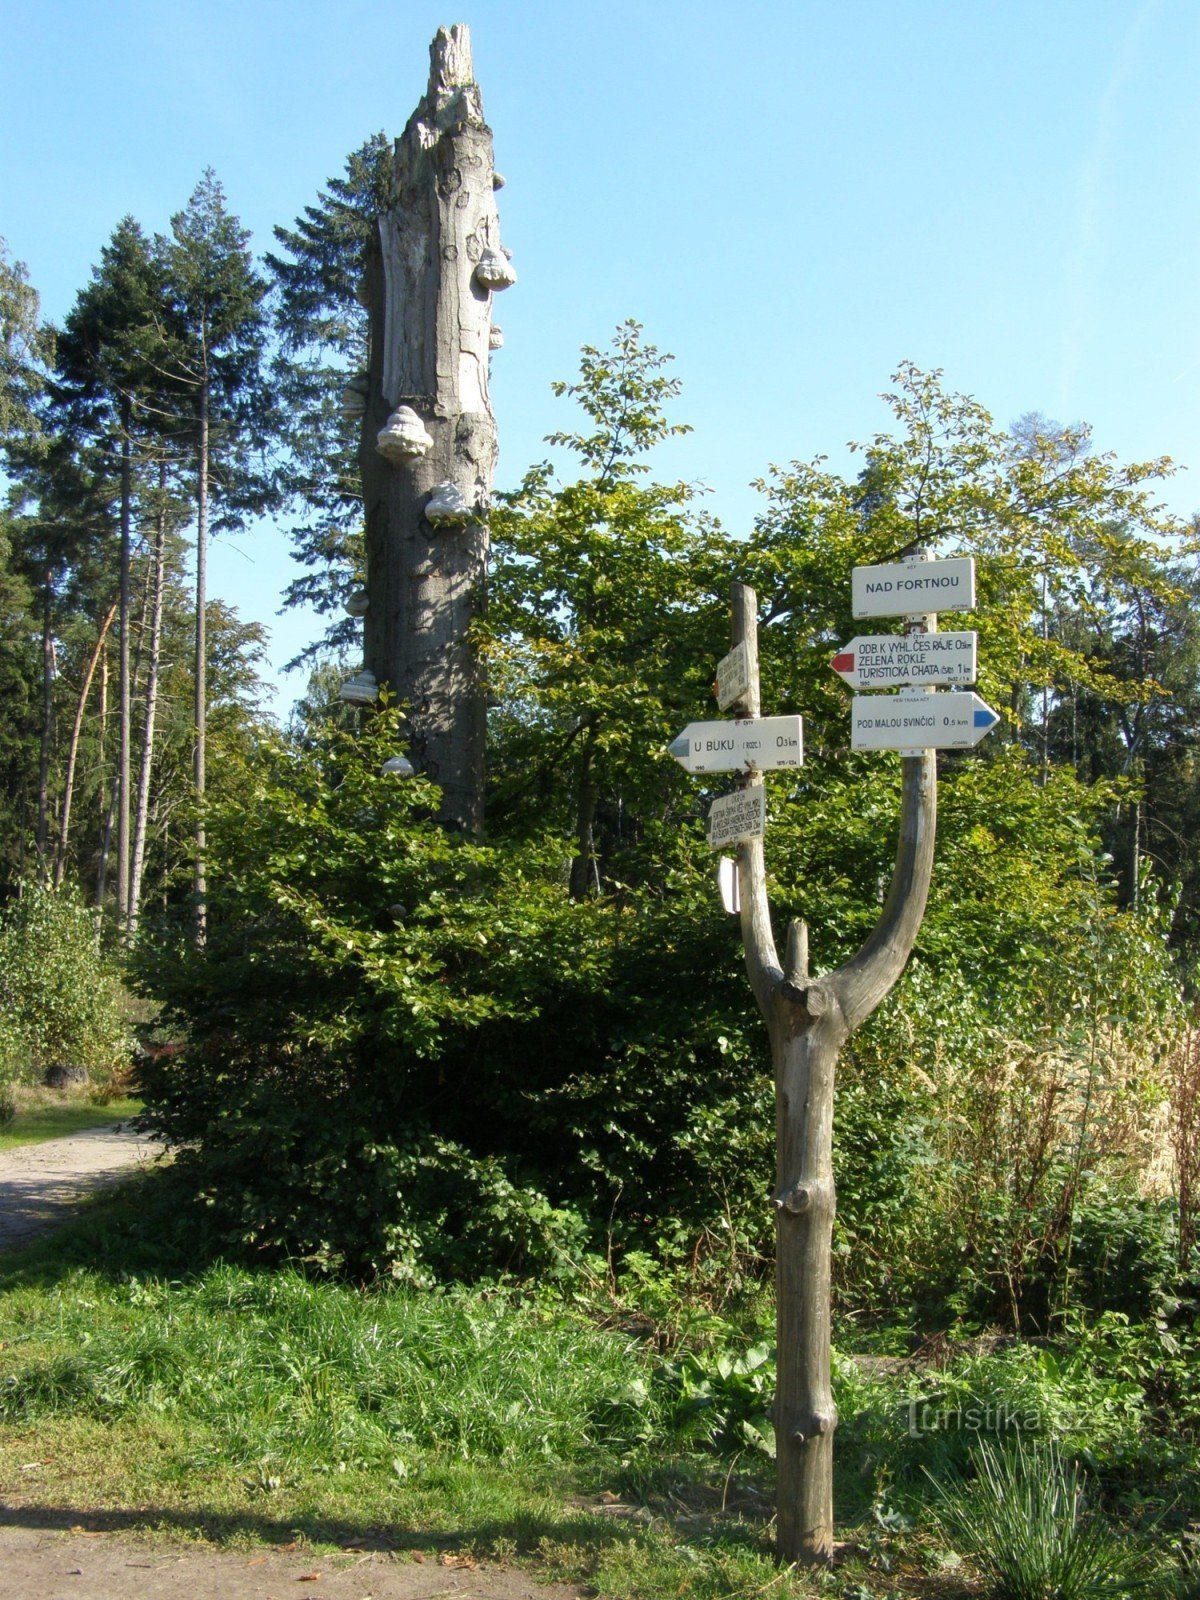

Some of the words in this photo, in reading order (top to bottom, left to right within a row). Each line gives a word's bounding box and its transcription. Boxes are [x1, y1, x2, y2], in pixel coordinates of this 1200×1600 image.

[866, 582, 893, 593] NAD
[896, 576, 959, 591] FORTNOU
[880, 643, 886, 653] K
[932, 638, 953, 651] RÁJE
[859, 652, 893, 666] ZELENÁ
[897, 653, 926, 664] ROKLE
[858, 664, 909, 678] TURISTICKÁ
[911, 664, 940, 676] CHATA
[857, 719, 873, 728] POD
[874, 718, 901, 728] MALOU
[903, 715, 936, 727] SVINČICÍ
[957, 718, 968, 726] km
[694, 742, 702, 752] U
[706, 739, 734, 752] BUKU
